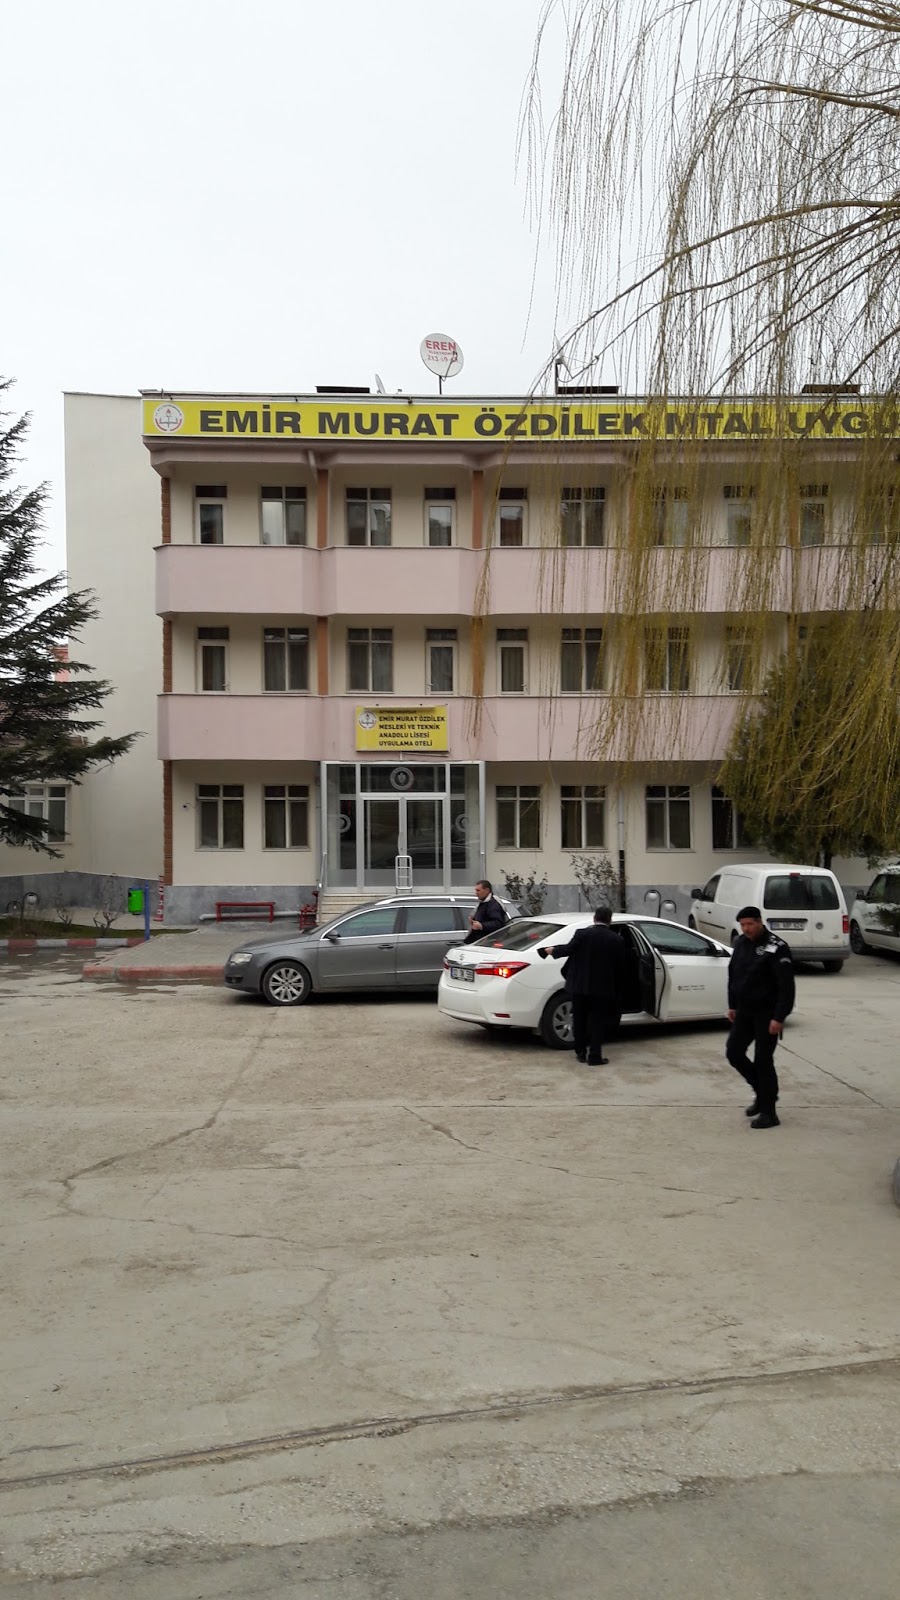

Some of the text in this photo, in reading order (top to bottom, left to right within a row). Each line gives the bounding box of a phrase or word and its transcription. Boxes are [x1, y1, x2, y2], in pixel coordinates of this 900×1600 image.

[425, 339, 457, 352] EREN
[200, 404, 302, 433] EMİR
[318, 411, 459, 436] MURAT
[474, 407, 650, 437] ÖZDİLEK
[665, 411, 773, 435] MTAL
[415, 739, 433, 747] OTELİ
